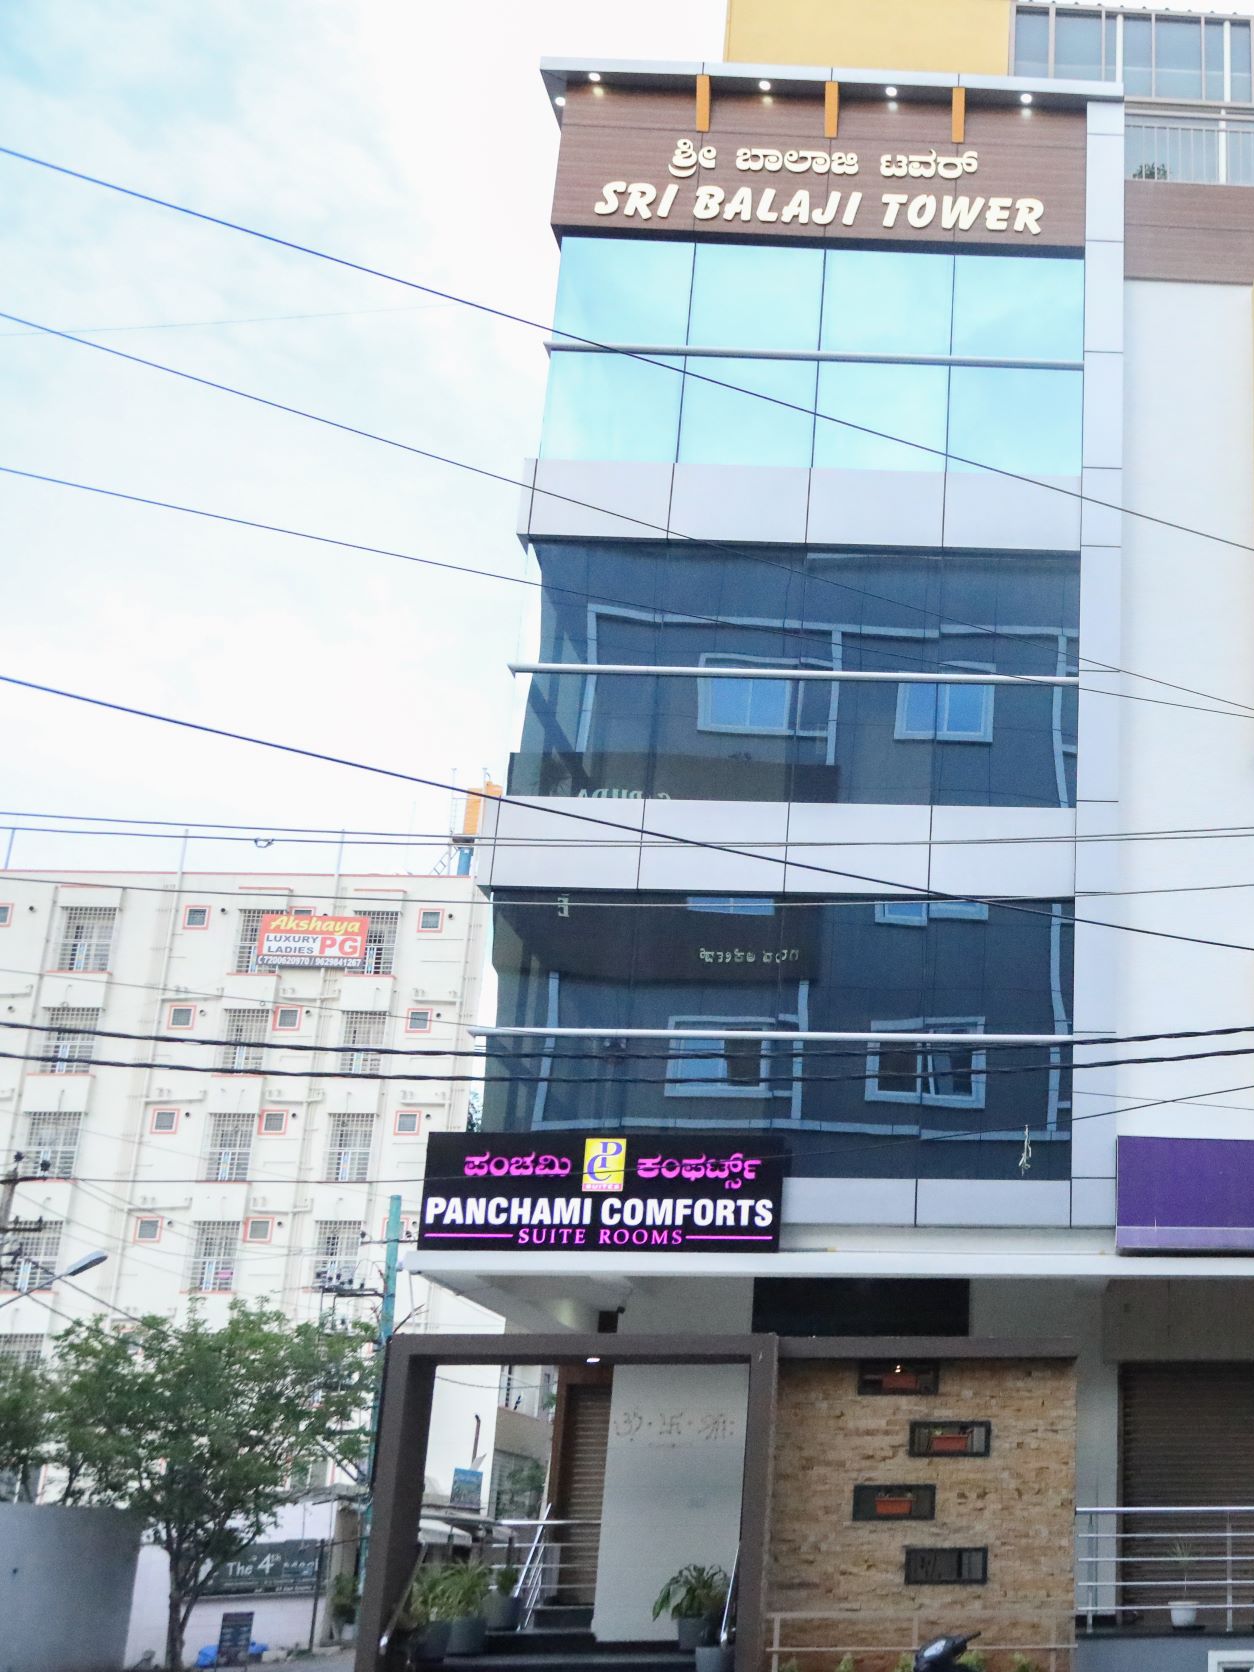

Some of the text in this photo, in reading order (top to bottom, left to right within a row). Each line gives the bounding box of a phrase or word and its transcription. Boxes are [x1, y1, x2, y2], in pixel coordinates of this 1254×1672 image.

[668, 138, 979, 180] ಶ್ರೀ ಬಾಲಾಜಿ ಟವರ್
[594, 180, 1045, 236] SRI BALAJI TOWER
[271, 916, 361, 935] Akshaya
[266, 934, 319, 943] LUXURY
[319, 936, 358, 956] PG
[267, 946, 314, 954] LADIES
[463, 1151, 572, 1178] ಪಂಚಮಿ
[425, 1197, 773, 1227] PANCHAMI COMFORTS
[517, 1228, 683, 1245] SUITE ROOMS
[226, 1561, 254, 1577] The
